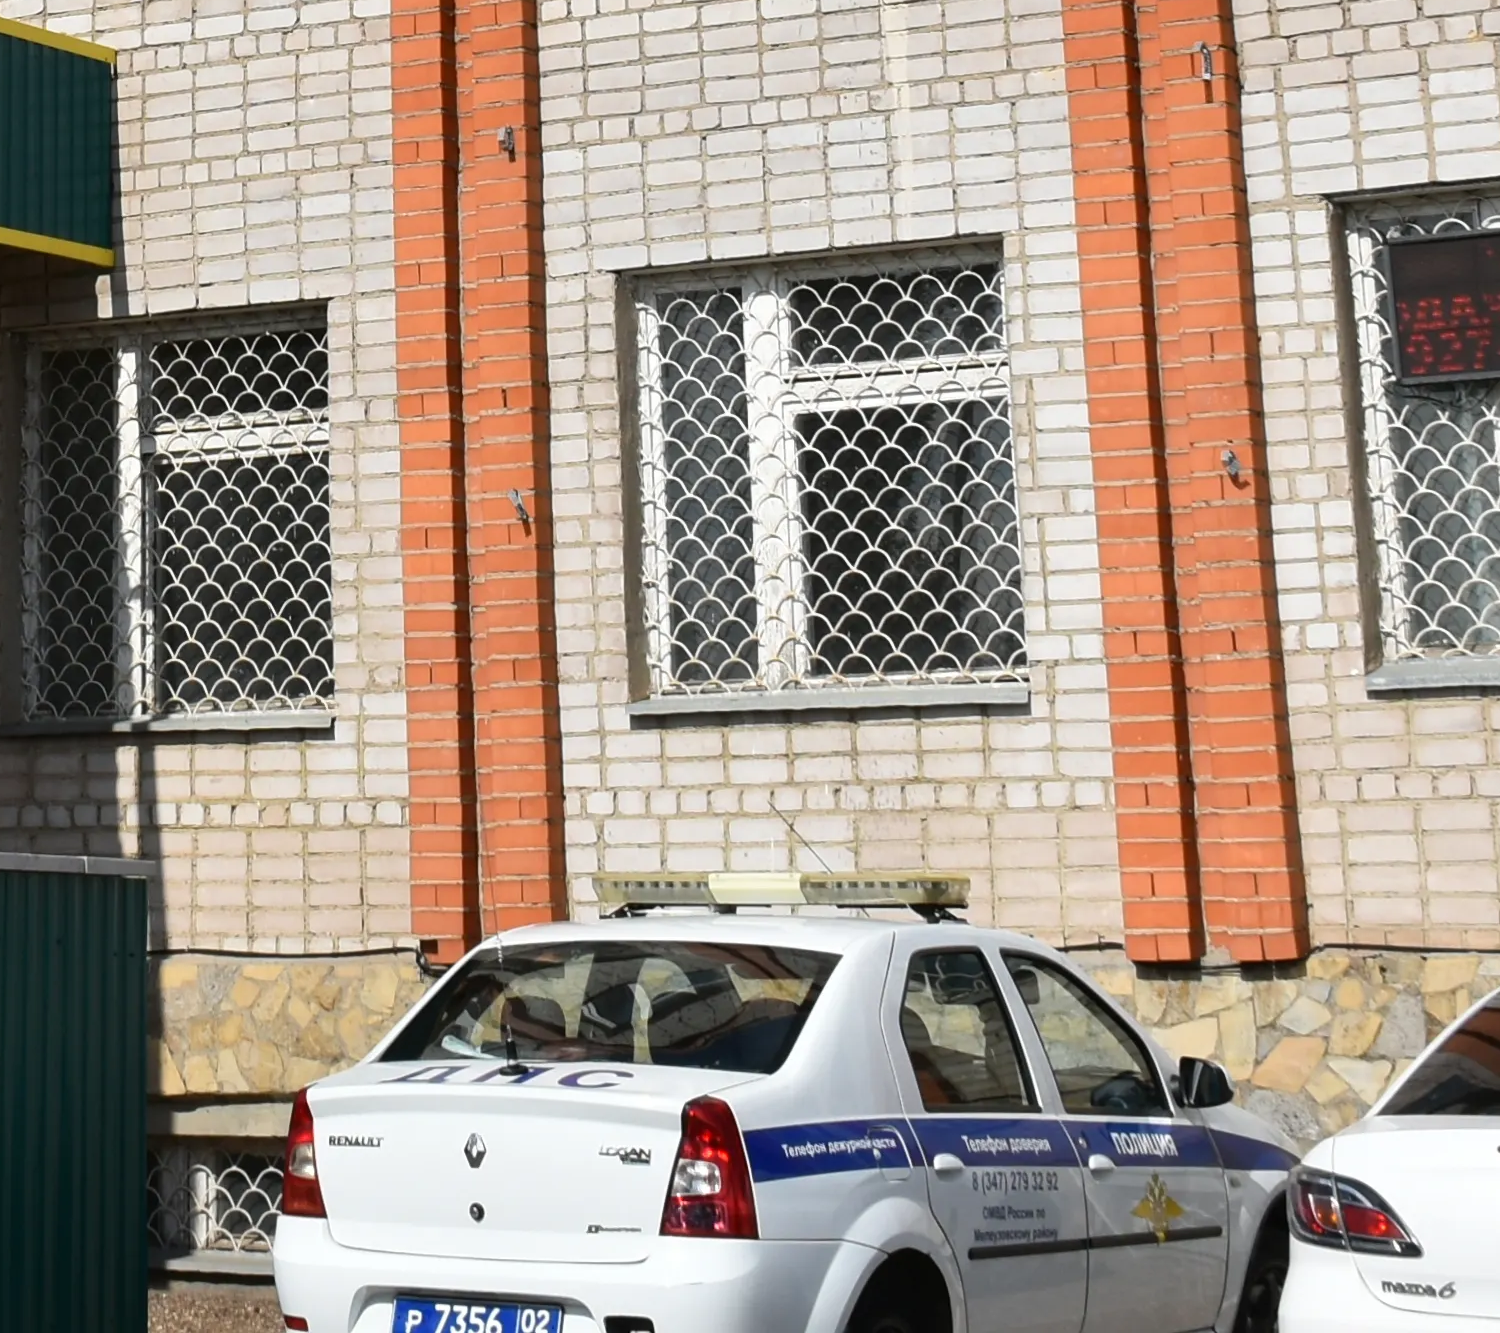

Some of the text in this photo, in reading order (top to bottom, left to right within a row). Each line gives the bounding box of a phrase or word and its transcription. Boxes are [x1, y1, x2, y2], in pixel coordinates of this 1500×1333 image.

[329, 1135, 385, 1148] RENAULT
[781, 1141, 828, 1159] Телефон
[961, 1134, 1052, 1157] Телефон доверия
[1109, 1132, 1179, 1159] ПОЛИЦИЯ
[971, 1170, 1059, 1197] 8 (347) 279 32 92
[521, 1309, 550, 1333] 02
